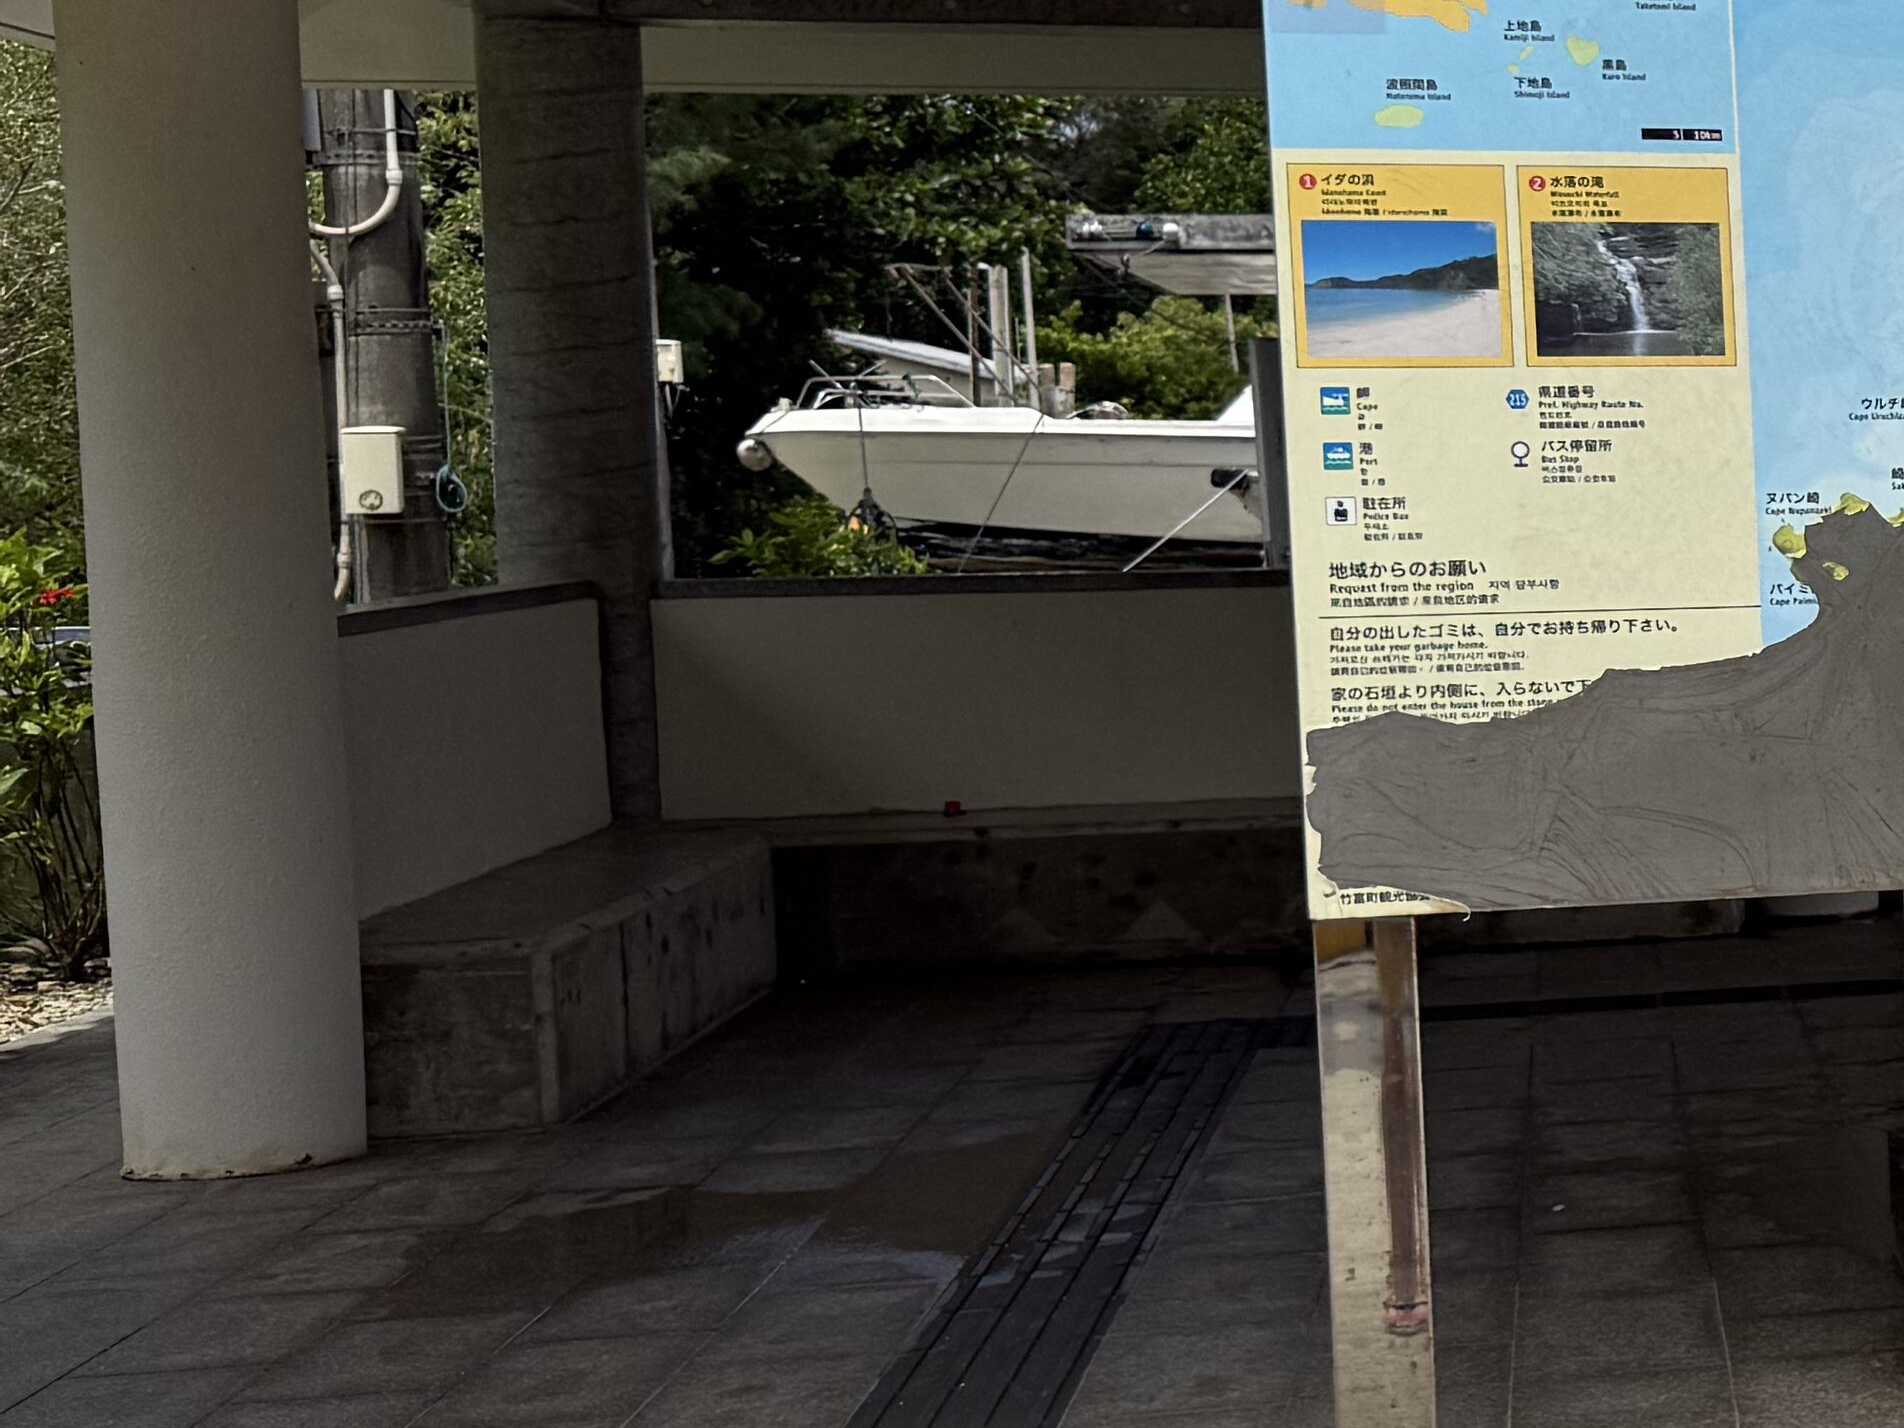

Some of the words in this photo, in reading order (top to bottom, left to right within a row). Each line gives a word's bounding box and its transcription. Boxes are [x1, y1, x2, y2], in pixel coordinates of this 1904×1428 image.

[1673, 3, 1696, 11] Island
[1504, 21, 1541, 32] 上地島
[1514, 77, 1552, 89] 下地島
[1510, 393, 1526, 406] 215
[1356, 403, 1378, 412] Cape
[1849, 413, 1868, 422] Cape
[1542, 439, 1612, 452] バス停留所
[1363, 497, 1406, 510] 駐在所
[1765, 507, 1785, 516] Cape
[1329, 559, 1487, 579] 地域からのお願い
[1330, 583, 1377, 594] Request
[1381, 582, 1408, 592] from
[1413, 581, 1432, 591] the
[1436, 581, 1474, 593] region
[1770, 598, 1790, 607] Cape
[1330, 644, 1361, 652] Please
[1365, 643, 1386, 652] take
[1389, 644, 1411, 653] your
[1415, 642, 1454, 652] garbage
[1457, 640, 1488, 650] home.
[1332, 704, 1363, 712] Please
[1367, 703, 1378, 712] do
[1431, 701, 1446, 710] the
[1450, 700, 1478, 709] house
[1482, 699, 1505, 708] from
[1508, 699, 1523, 707] the
